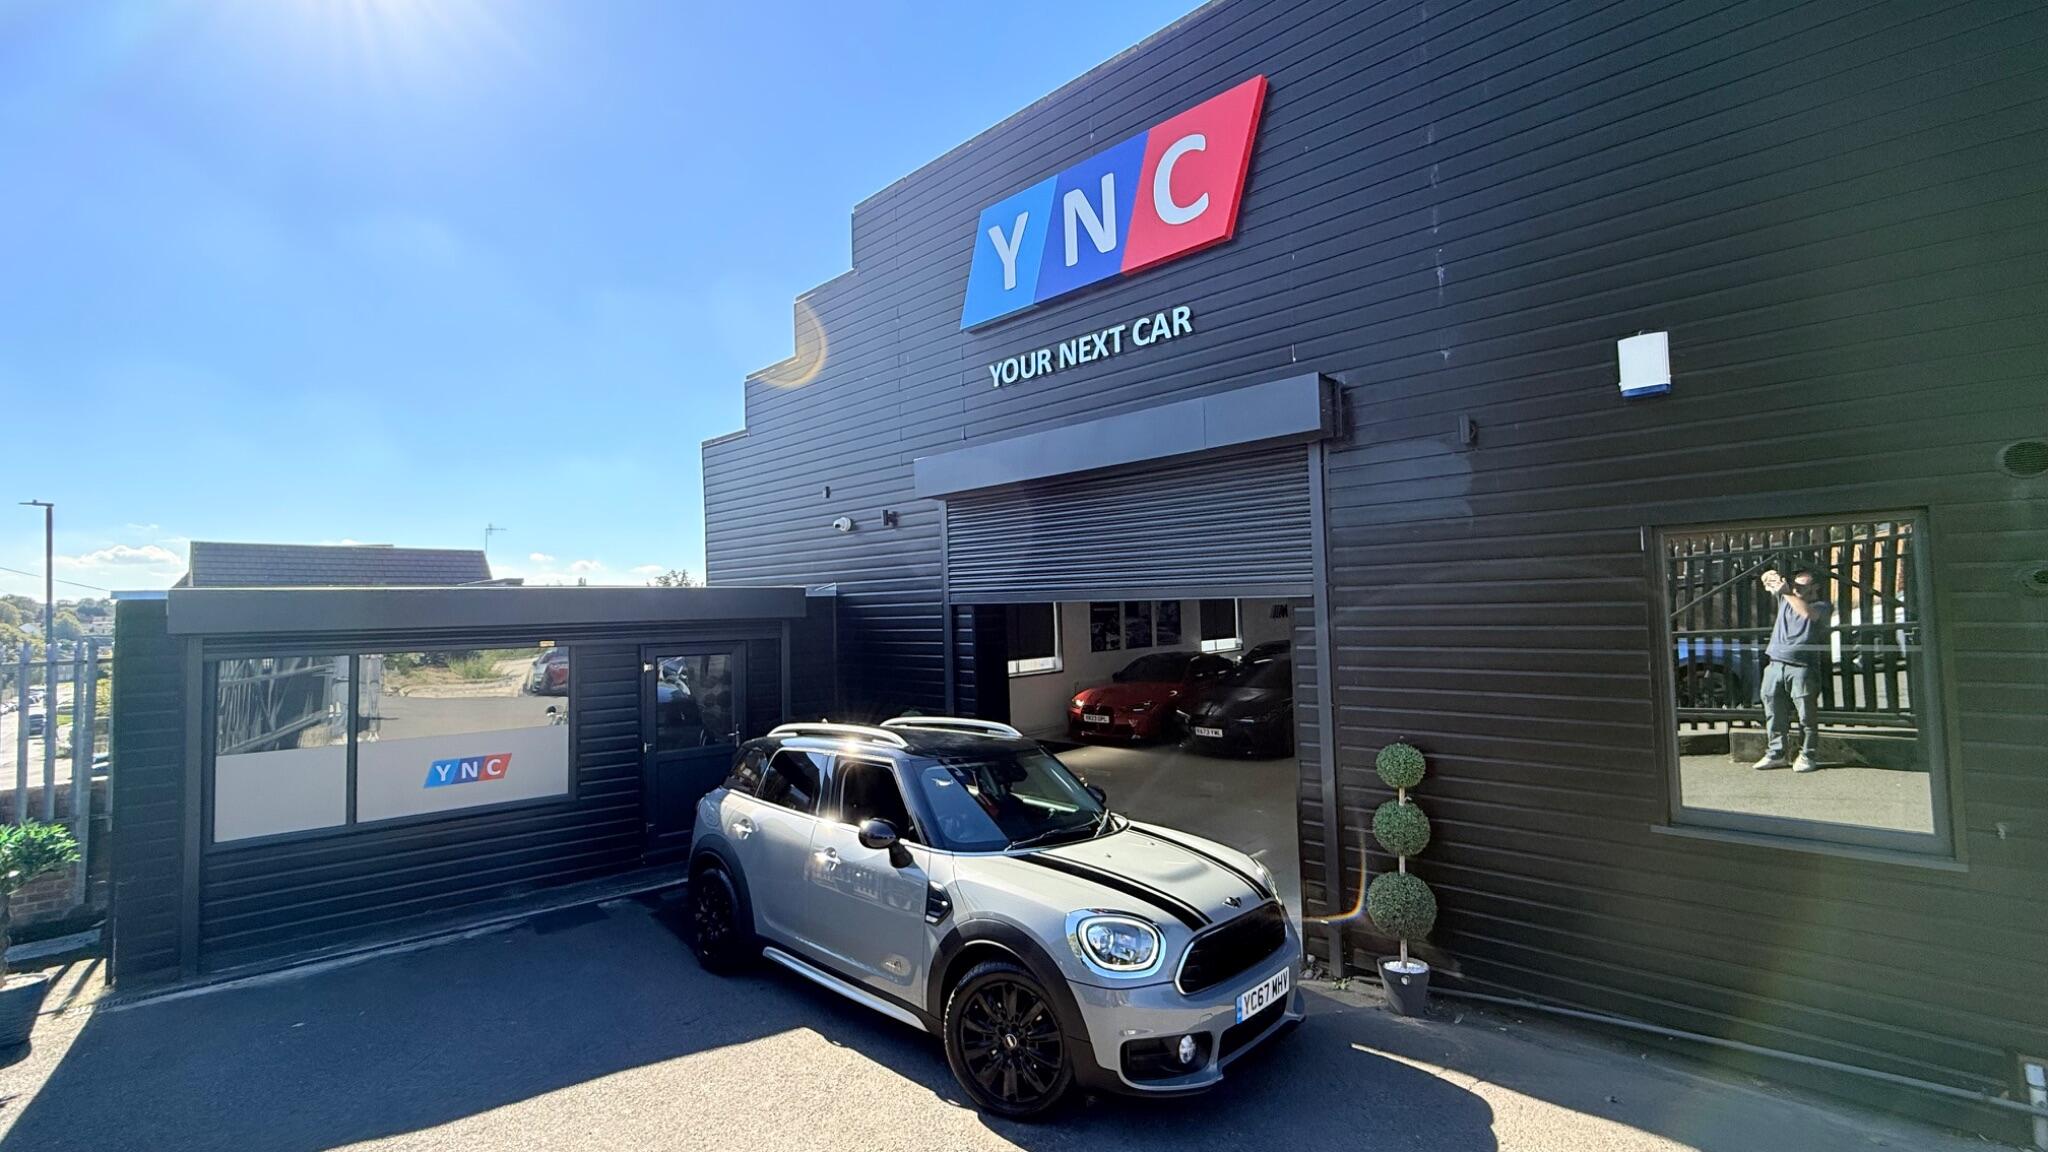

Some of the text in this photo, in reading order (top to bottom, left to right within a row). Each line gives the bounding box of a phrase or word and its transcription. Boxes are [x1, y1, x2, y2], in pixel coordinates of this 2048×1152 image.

[988, 133, 1210, 291] YNC
[988, 305, 1193, 388] YOUR NEXT CAR
[435, 758, 502, 782] YNC
[1243, 970, 1289, 1015] YC67 MHV
